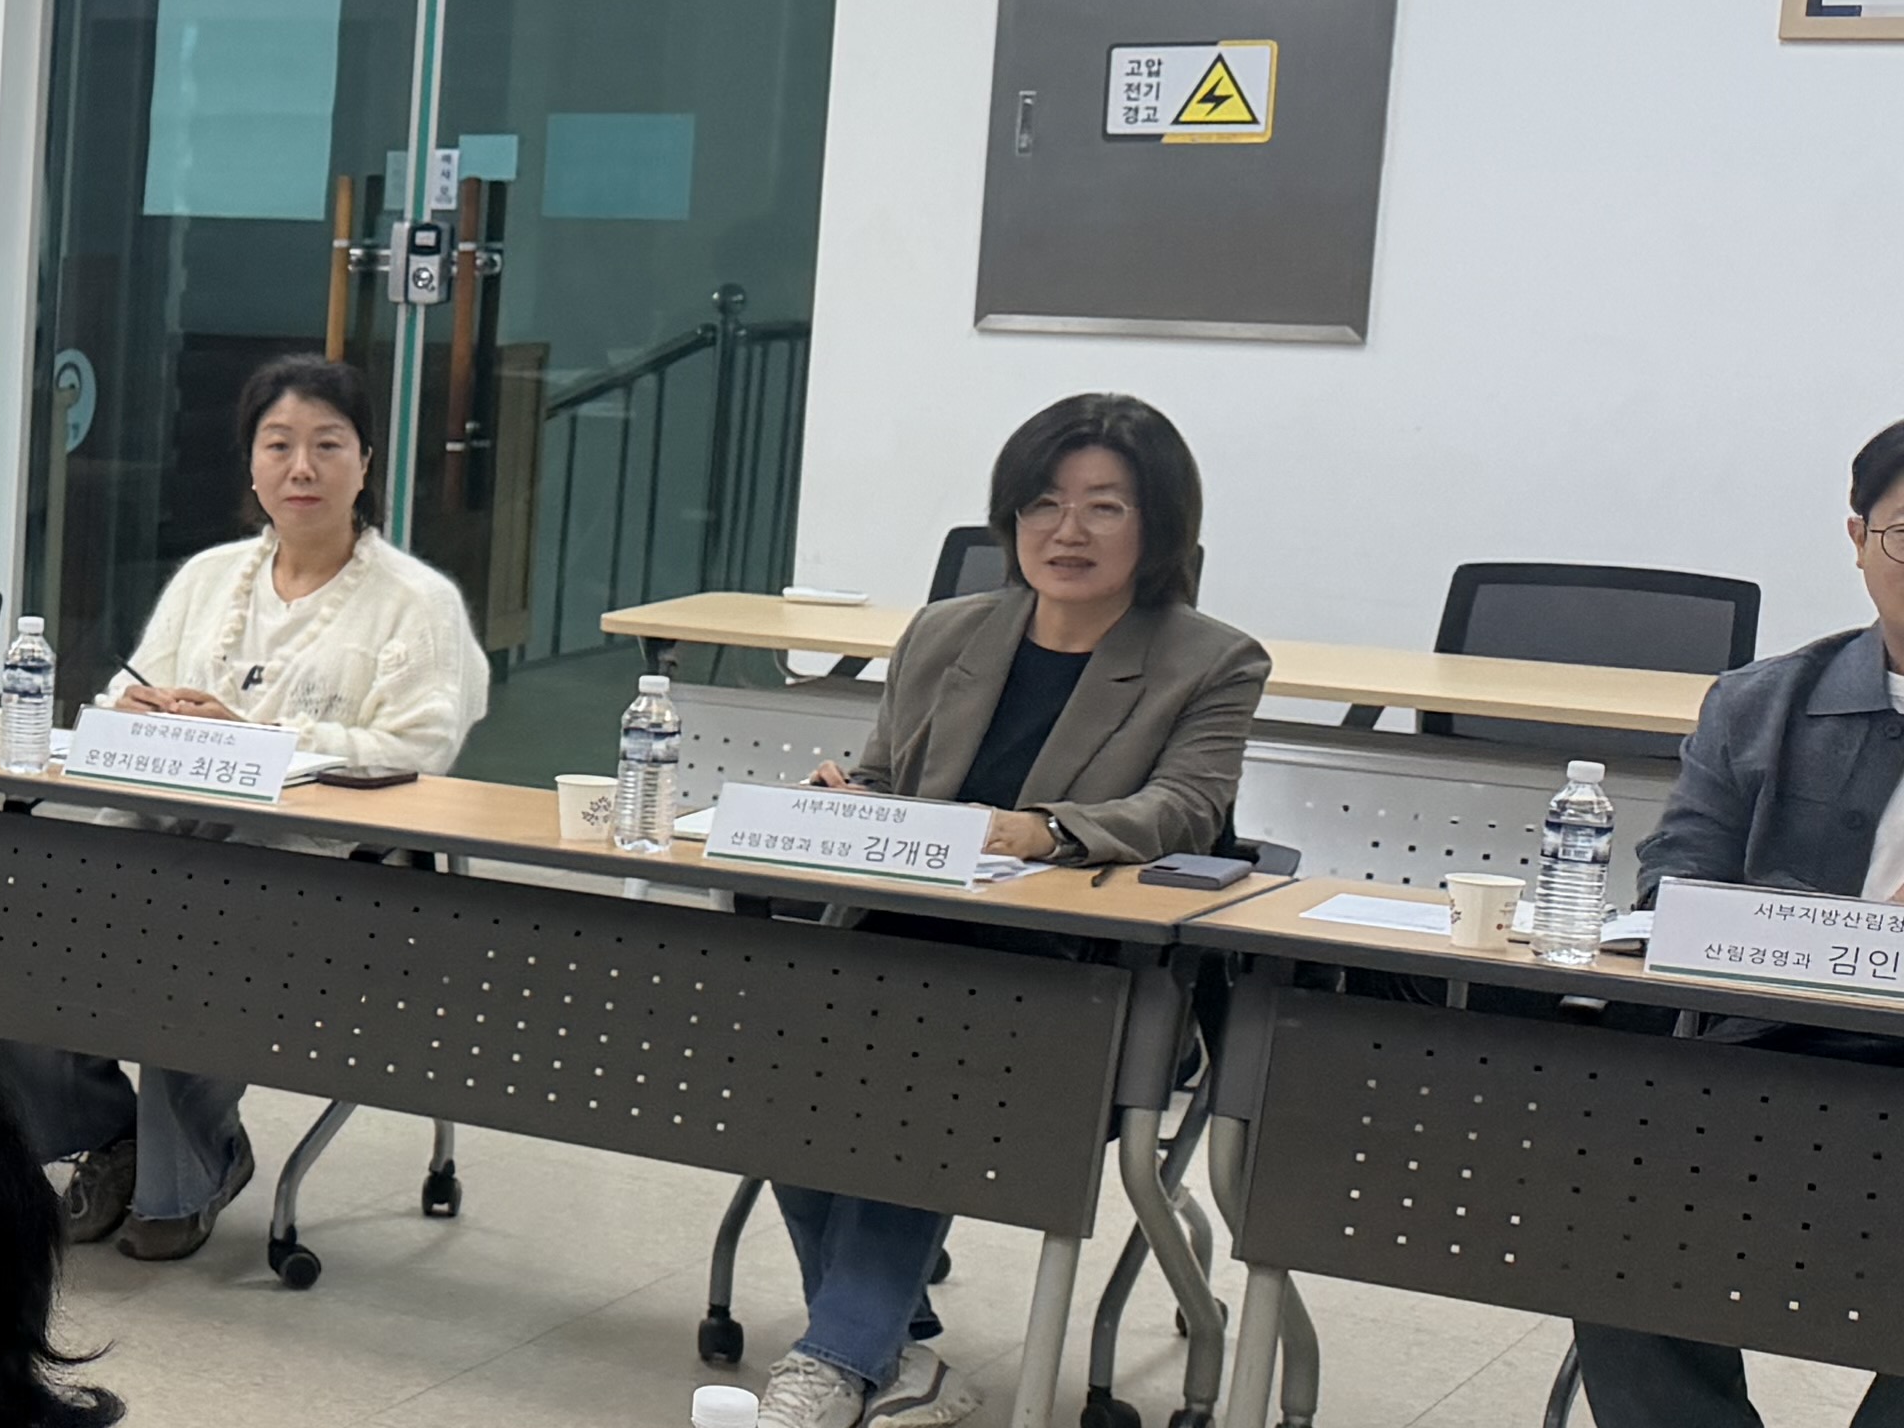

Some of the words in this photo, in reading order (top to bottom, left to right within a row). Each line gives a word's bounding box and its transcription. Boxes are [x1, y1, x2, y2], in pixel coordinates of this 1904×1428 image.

[1125, 58, 1163, 78] 고압
[1124, 82, 1160, 101] 전기
[1123, 106, 1159, 124] 경고
[189, 756, 262, 787] 최정금
[792, 798, 907, 823] 서부지방산림청
[730, 831, 812, 853] 산림경영과
[820, 839, 852, 857] 팀장
[863, 835, 950, 870] 김개명
[1704, 943, 1812, 969] 산림경영과
[1828, 945, 1900, 981] 김인
